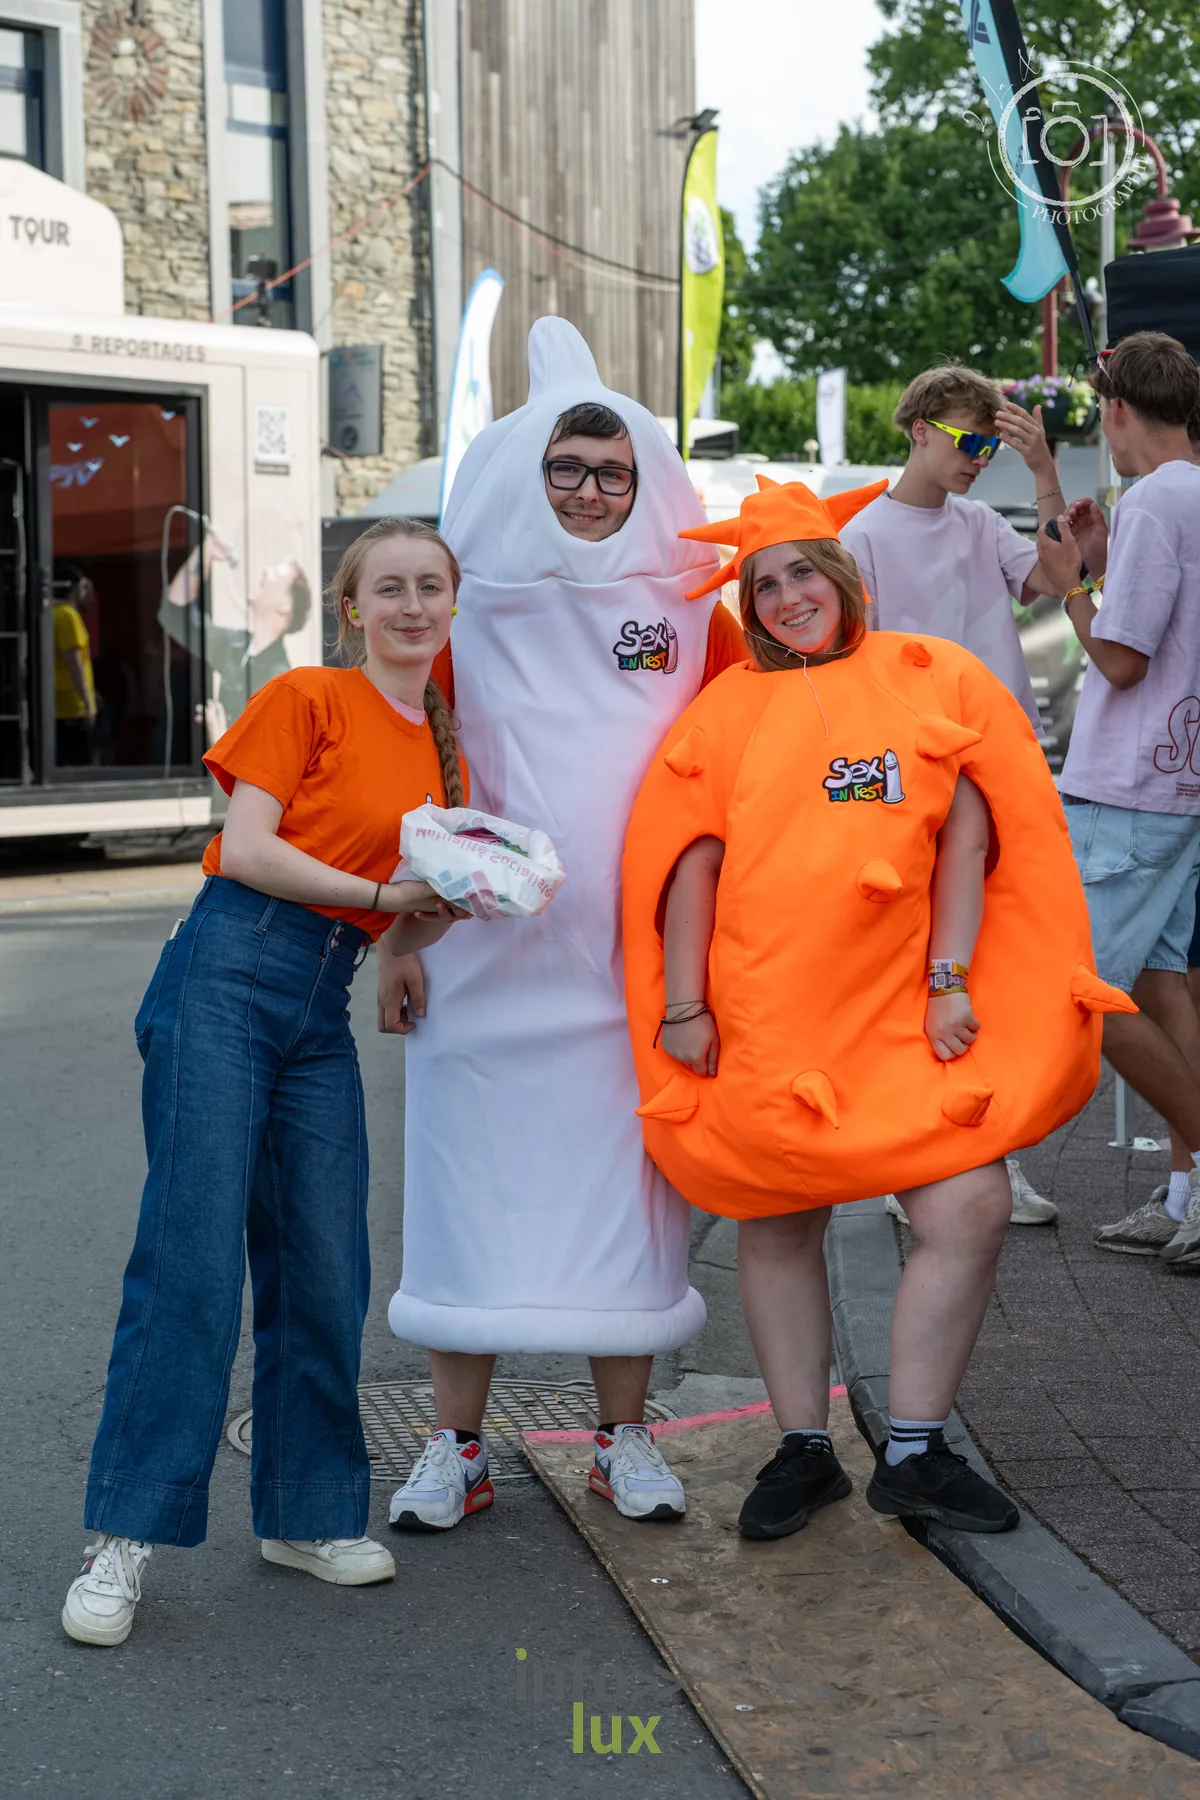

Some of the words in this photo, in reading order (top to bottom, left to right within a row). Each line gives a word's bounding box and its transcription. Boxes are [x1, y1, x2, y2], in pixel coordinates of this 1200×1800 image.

[9, 214, 71, 248] TOUR
[90, 335, 207, 363] REPORTAGES
[613, 620, 668, 656] Sex
[822, 756, 884, 789] Sex
